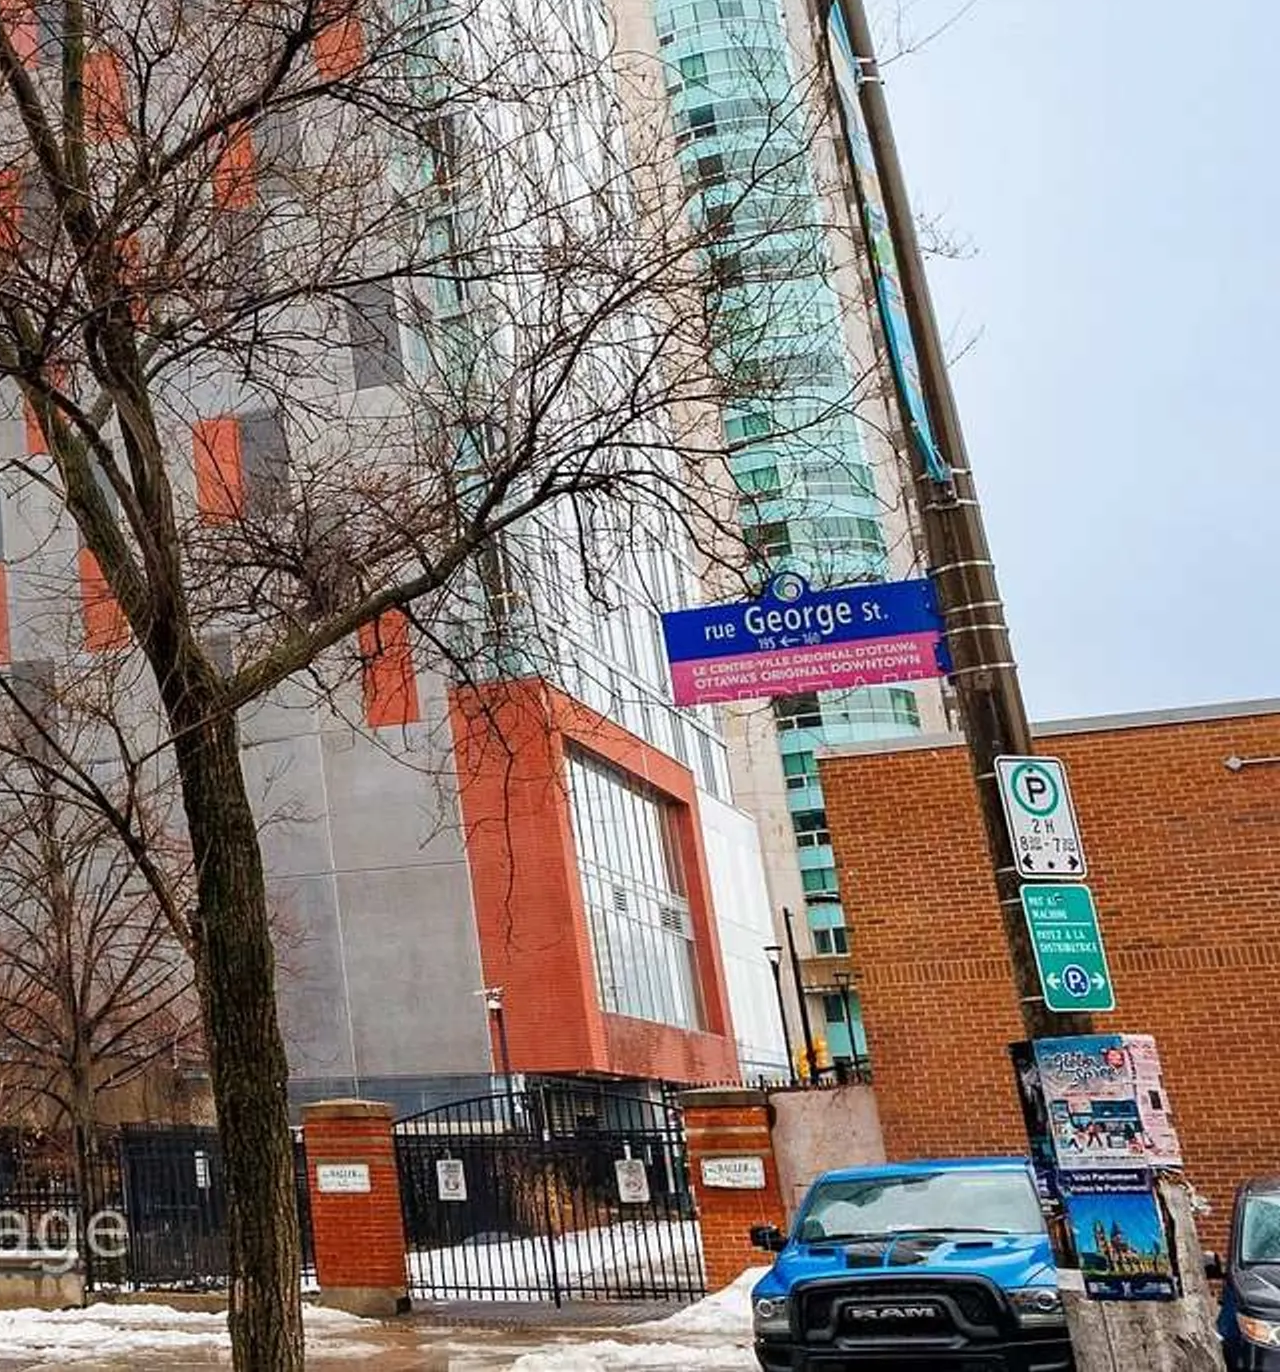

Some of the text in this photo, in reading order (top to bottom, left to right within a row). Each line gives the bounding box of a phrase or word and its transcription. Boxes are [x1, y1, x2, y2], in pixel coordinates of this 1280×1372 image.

[704, 601, 889, 641] rue George St.
[691, 666, 707, 678] LE
[792, 648, 853, 664] ORIGINAL
[760, 664, 829, 682] ORIGINAL
[831, 653, 922, 674] DOWNTOWN
[851, 1307, 936, 1319] RAM
